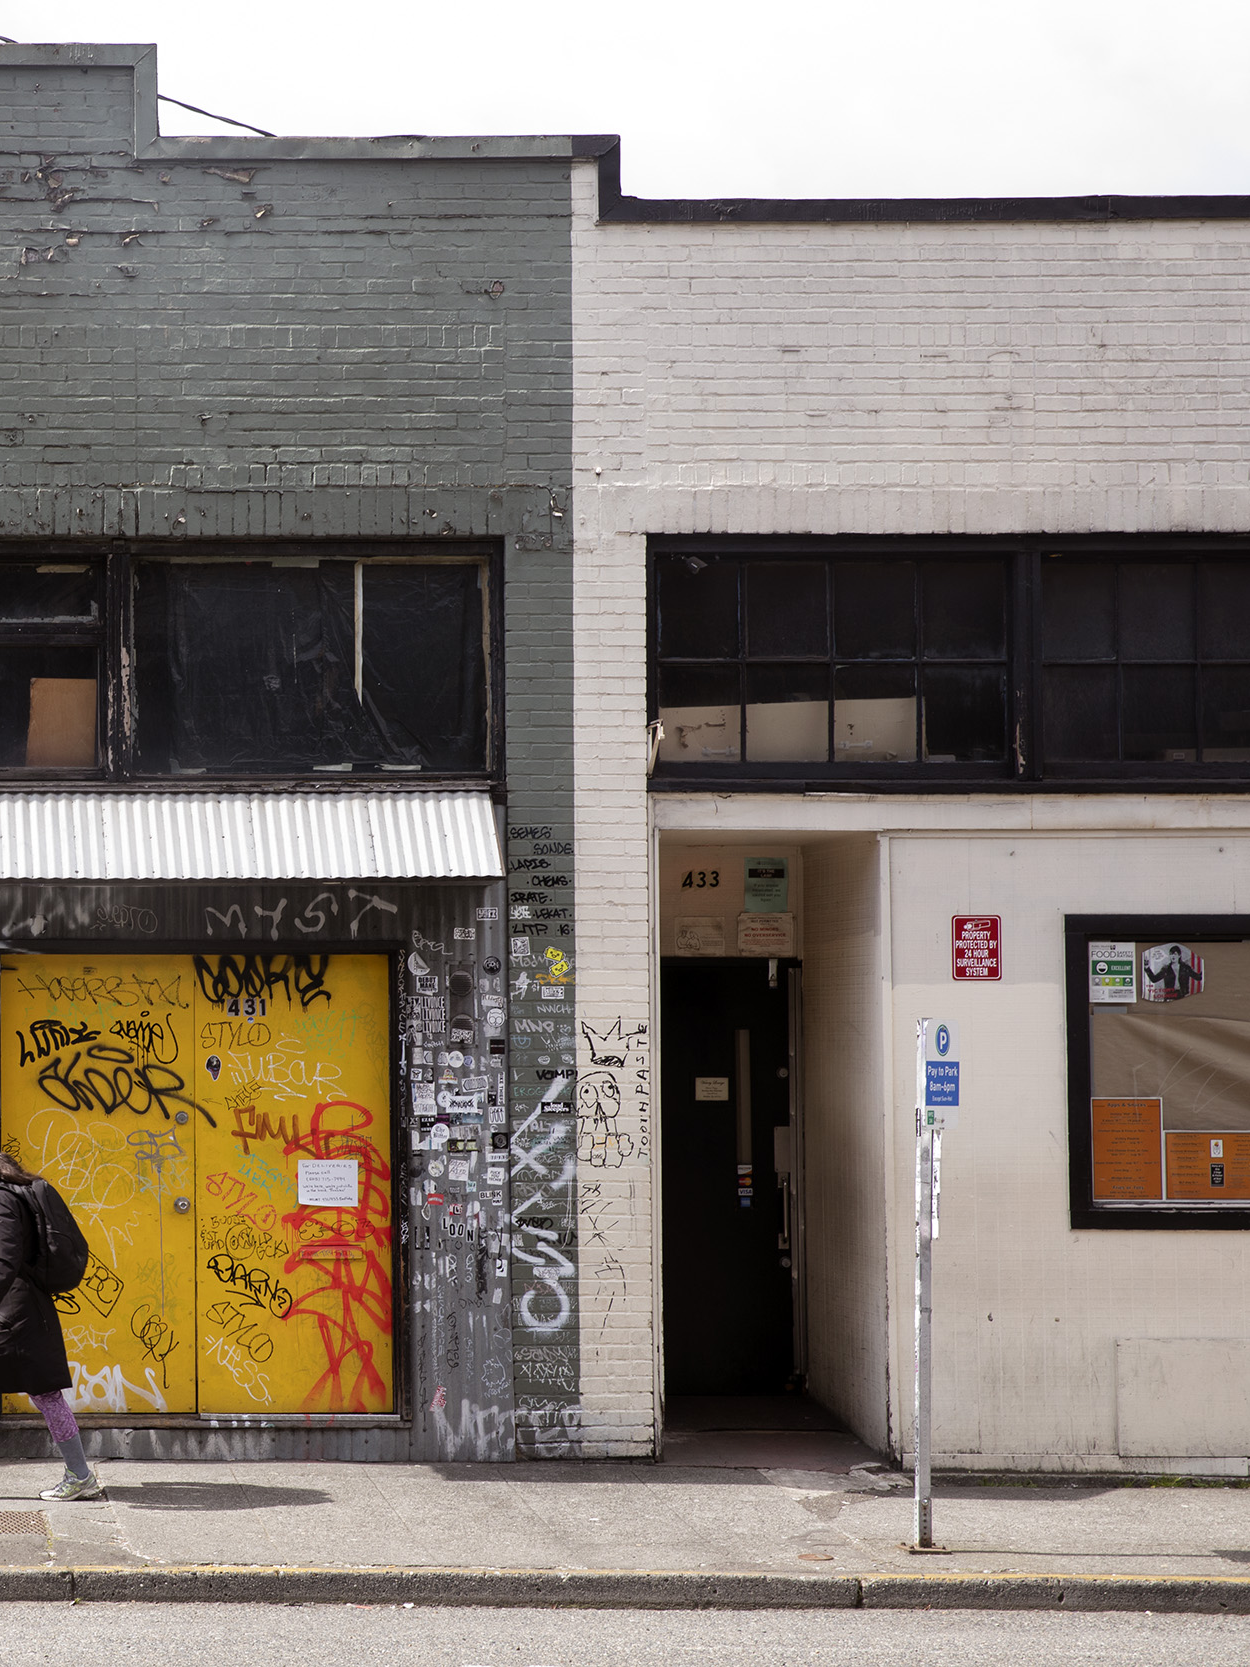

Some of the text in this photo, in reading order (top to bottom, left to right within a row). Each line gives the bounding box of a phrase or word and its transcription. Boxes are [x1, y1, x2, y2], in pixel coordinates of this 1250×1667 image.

[682, 870, 720, 888] 433
[205, 888, 398, 941] MYST
[962, 931, 991, 940] PROPERTY
[956, 940, 997, 949] PROTECTED BY
[964, 949, 988, 958] 24 HOUR
[1091, 950, 1116, 958] FOOD
[956, 958, 997, 967] SURVEILLANCE
[966, 967, 988, 976] SYSTEM
[228, 998, 266, 1016] 431
[939, 1032, 947, 1050] P
[536, 1070, 578, 1080] VOMP!
[928, 1066, 958, 1078] Pay to Park
[930, 1081, 956, 1094] 8am-6pm
[480, 1190, 502, 1198] BLINK
[443, 1218, 474, 1241] LOON
